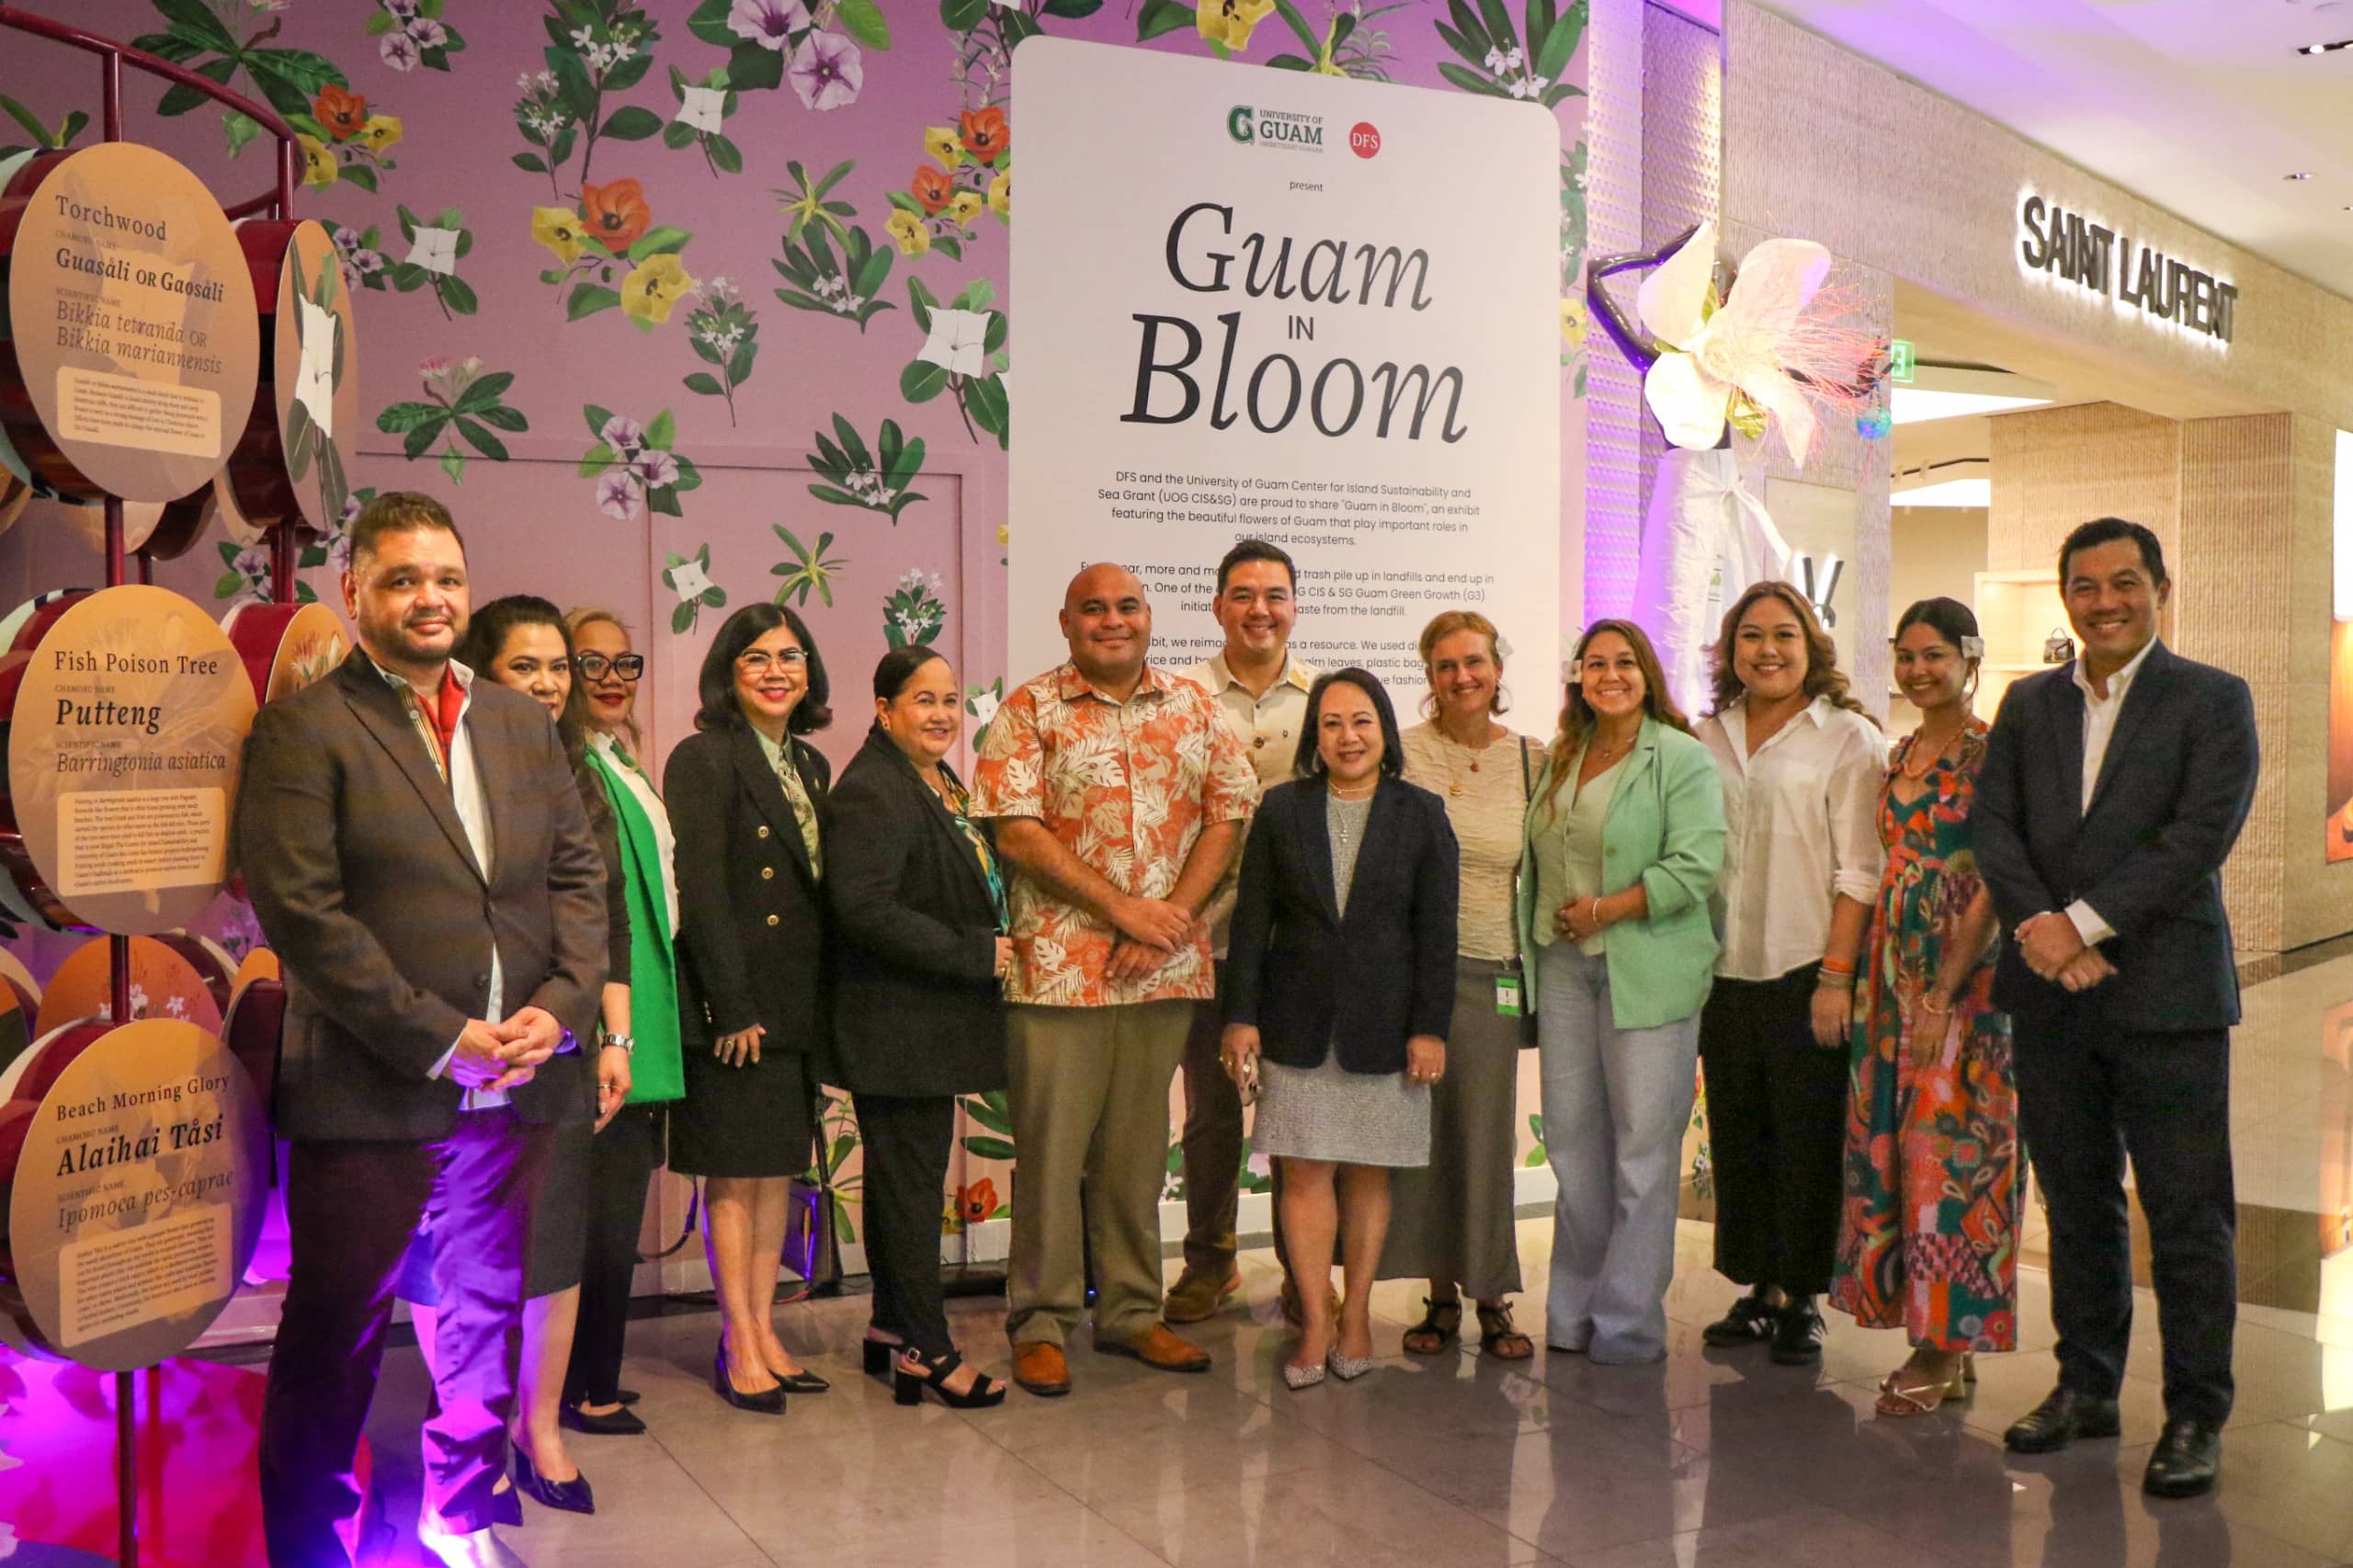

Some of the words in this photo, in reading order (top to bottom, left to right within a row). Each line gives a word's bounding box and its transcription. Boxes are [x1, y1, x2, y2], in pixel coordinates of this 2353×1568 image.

[1260, 109, 1312, 123] UNIVERSITY
[1313, 117, 1324, 125] OF
[1260, 120, 1323, 145] GUAM
[1353, 132, 1379, 150] DFS
[1290, 181, 1324, 192] present
[55, 195, 166, 241] Torchwood
[1166, 202, 1432, 311] Guam
[56, 248, 130, 281] Guasåli
[136, 269, 156, 288] OR
[161, 272, 224, 302] Gaosåli
[2022, 196, 2114, 295] SAINT
[2120, 237, 2237, 343] LAURENT
[57, 301, 109, 329] Bikkia
[118, 314, 185, 344] tetranda
[190, 330, 207, 347] OR
[1288, 314, 1313, 340] IN
[57, 326, 109, 354] Bikkia
[118, 343, 222, 374] mariannensis
[1120, 311, 1468, 444] Bloom
[1116, 472, 1137, 483] DFS
[1140, 473, 1162, 483] and
[1165, 474, 1184, 484] the
[1187, 475, 1238, 490] University
[1242, 478, 1252, 488] of
[1256, 479, 1288, 490] Guam
[1291, 480, 1327, 492] Center
[1331, 482, 1344, 493] for
[1347, 483, 1378, 494] Island
[1381, 484, 1449, 499] Sustainability
[1451, 488, 1471, 498] and
[1098, 489, 1120, 500] Sea
[1123, 490, 1154, 501] Grant
[1159, 489, 1188, 504] (UOG
[1192, 493, 1236, 507] CIS&SG)
[1240, 497, 1257, 506] are
[1261, 498, 1292, 509] proud
[1296, 499, 1306, 509] to
[1309, 499, 1338, 510] share
[1342, 500, 1377, 512] "Guam
[1381, 502, 1389, 511] in
[1392, 502, 1429, 515] Bloom",
[1432, 506, 1444, 514] an
[1448, 505, 1480, 516] exhibit
[1112, 507, 1164, 523] featuring
[1167, 511, 1185, 521] the
[1188, 511, 1236, 523] beautiful
[1240, 513, 1278, 525] flowers
[1280, 515, 1290, 525] of
[1294, 516, 1326, 528] Guam
[1330, 517, 1350, 528] that
[1353, 517, 1376, 531] play
[1380, 519, 1429, 532] important
[1433, 521, 1456, 531] roles
[1459, 522, 1468, 531] in
[1234, 533, 1252, 542] our
[1256, 532, 1288, 542] island
[1290, 534, 1357, 547] ecosystems.
[1145, 565, 1174, 574] more
[1178, 566, 1200, 575] and
[1304, 570, 1331, 580] trash
[1334, 571, 1352, 583] pile
[1356, 573, 1369, 583] up
[1371, 571, 1381, 581] in
[1383, 572, 1422, 583] landfills
[1425, 573, 1444, 583] and
[1448, 573, 1467, 583] end
[1470, 574, 1483, 585] up
[1485, 574, 1494, 584] in
[1154, 583, 1177, 593] One
[1181, 583, 1191, 593] of
[1195, 584, 1212, 594] the
[1308, 586, 1325, 597] CIS
[1328, 587, 1336, 597] &
[1339, 588, 1352, 597] SG
[1356, 588, 1388, 598] Guam
[1391, 589, 1421, 599] Green
[1424, 589, 1461, 600] Growth
[1463, 589, 1485, 603] (G3)
[1181, 600, 1213, 612] initiat
[1297, 605, 1320, 615] aste
[1323, 605, 1347, 615] from
[1351, 606, 1368, 616] the
[1370, 606, 1406, 616] landfill.
[1149, 636, 1167, 648] bit,
[1171, 639, 1187, 648] we
[1190, 637, 1226, 648] reima
[1310, 642, 1358, 651] resource.
[1360, 641, 1377, 651] We
[1380, 641, 1405, 651] used
[1407, 640, 1417, 651] di
[55, 651, 97, 671] Fish
[106, 653, 169, 673] Poison
[177, 656, 218, 675] Tree
[1169, 655, 1191, 665] and
[1327, 657, 1362, 669] leaves,
[1367, 658, 1401, 670] plastic
[1404, 657, 1424, 670] bag
[96, 686, 116, 694] NAME
[56, 699, 162, 734] Putteng
[100, 741, 121, 749] NAME
[57, 752, 163, 778] Barringtonia
[168, 751, 226, 770] asiatica
[57, 1096, 106, 1121] Beach
[112, 1085, 181, 1109] Morning
[188, 1075, 230, 1095] Glory
[97, 1124, 119, 1136] NAME
[57, 1127, 160, 1176] Alaihai
[171, 1113, 223, 1150] Tåsi
[103, 1180, 125, 1192] NAME
